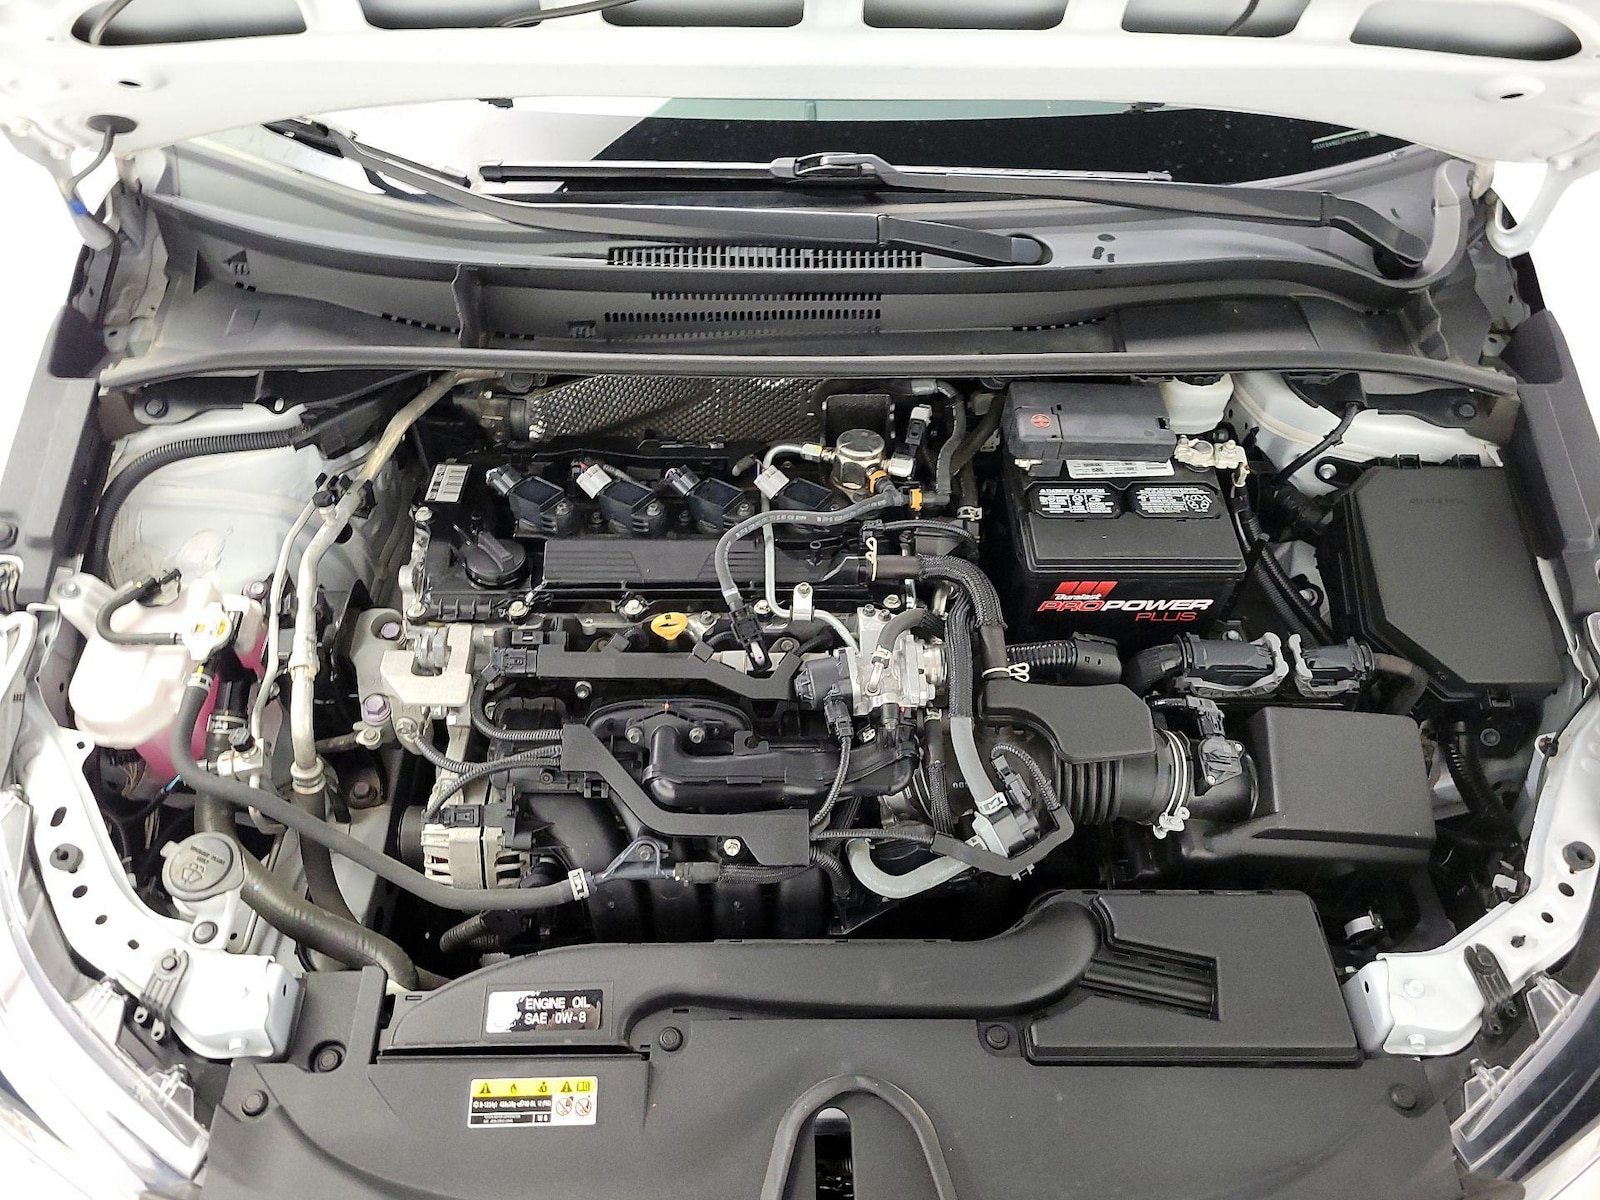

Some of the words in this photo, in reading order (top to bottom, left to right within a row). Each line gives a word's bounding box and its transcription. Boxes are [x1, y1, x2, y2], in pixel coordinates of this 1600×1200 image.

[1037, 599, 1214, 611] PROPOWER
[1135, 612, 1198, 622] PLUS
[525, 997, 565, 1010] ENGINE
[572, 996, 591, 1008] OIL
[524, 1012, 548, 1025] SAE
